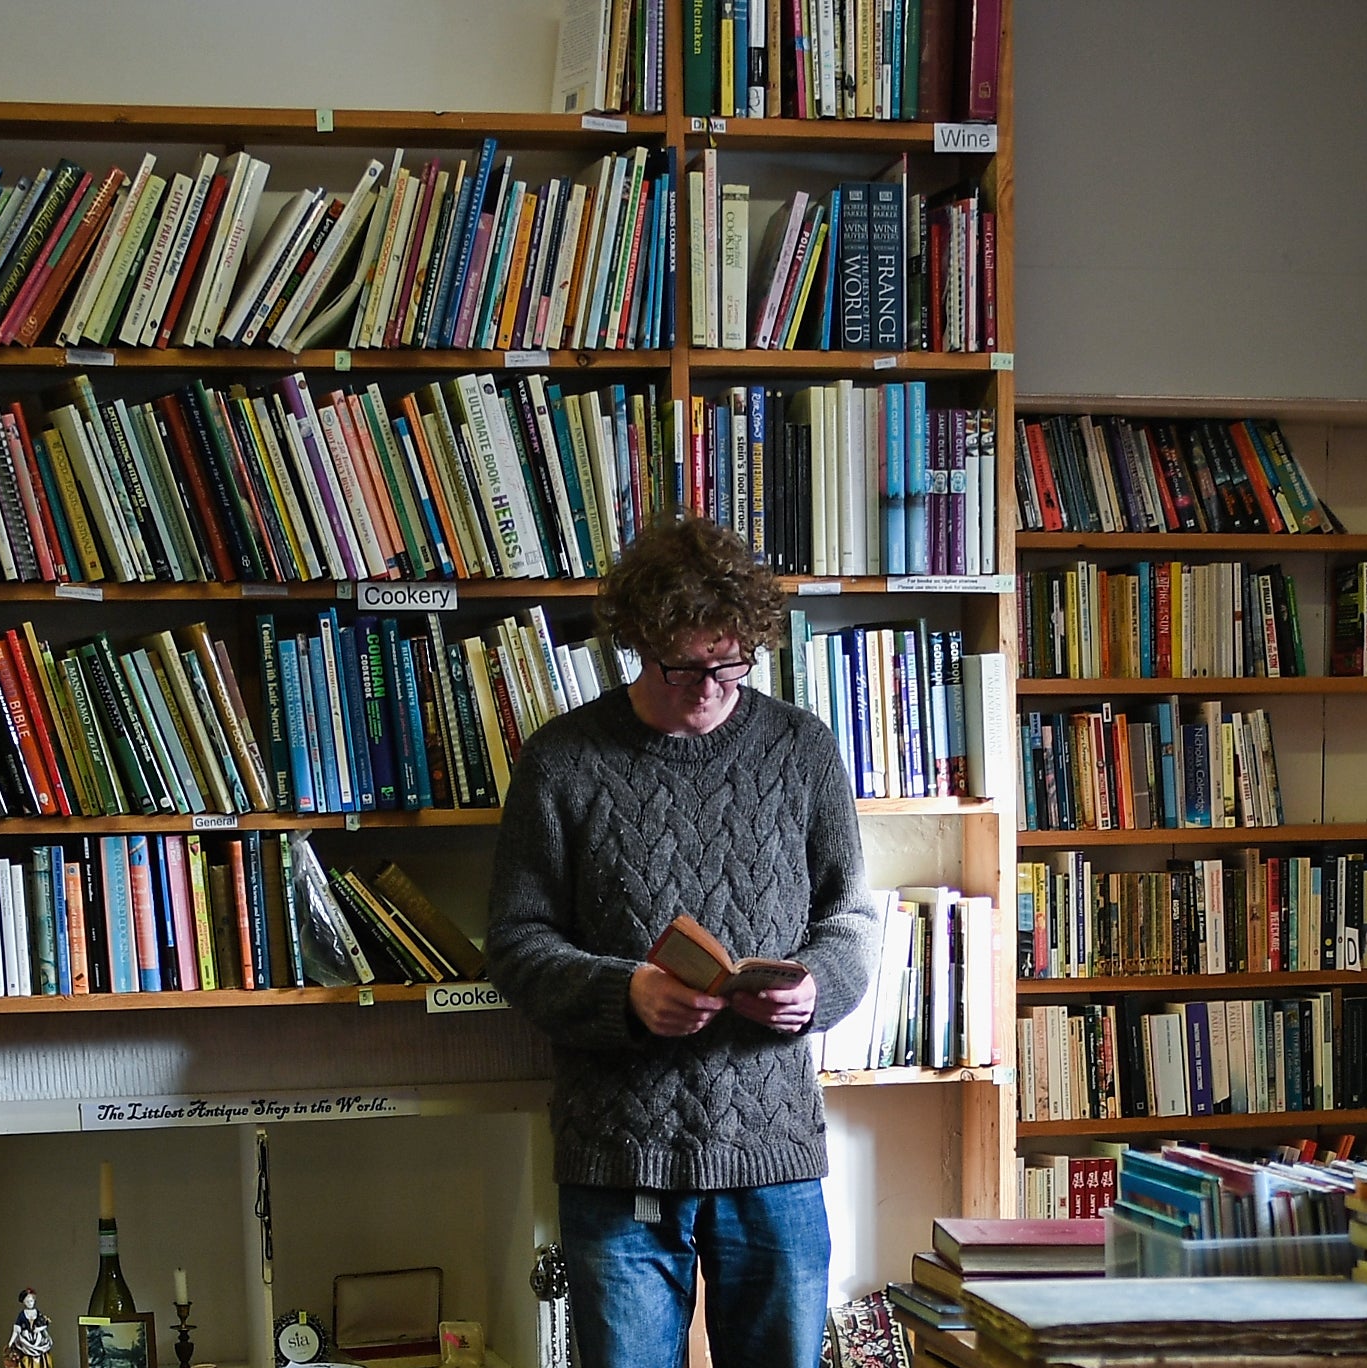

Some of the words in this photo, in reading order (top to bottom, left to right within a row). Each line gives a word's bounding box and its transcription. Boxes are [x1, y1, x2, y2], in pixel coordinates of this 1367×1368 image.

[693, 0, 702, 53] Heineken
[874, 21, 882, 43] wine
[874, 46, 882, 81] wisdom
[480, 143, 491, 163] THE
[940, 130, 990, 147] Wine
[36, 187, 65, 231] Complete
[163, 189, 183, 222] LITTLE
[387, 177, 406, 231] CARIBBEAN
[465, 166, 486, 229] VEGETARIAN
[19, 226, 45, 265] Chinese
[155, 222, 173, 248] PARIS
[221, 218, 248, 270] chinese
[724, 210, 734, 267] COOKERY
[793, 230, 810, 263] POLLY
[115, 239, 137, 279] KITCHEN
[140, 248, 164, 291] KITCHEN
[376, 234, 393, 277] COOKING
[452, 232, 471, 288] COOKBOOK
[844, 254, 863, 343] WORLD
[878, 255, 896, 343] FRANCE
[503, 396, 516, 417] WOK
[515, 378, 530, 404] WOK
[890, 387, 898, 409] JAMIE
[521, 403, 533, 415] &
[890, 410, 898, 436] OLIVER
[954, 411, 962, 435] JAMIE
[324, 426, 335, 444] HOT
[330, 445, 338, 453] &
[508, 417, 529, 466] COOKBOOK
[718, 437, 726, 455] THE
[105, 404, 132, 463] ENTERTAINING
[124, 461, 140, 484] WITH
[132, 482, 148, 509] TOVEY
[332, 452, 345, 474] SPICY
[737, 435, 748, 469] stein's
[954, 437, 962, 467] OLIVER
[445, 434, 461, 467] FONDUE
[455, 468, 472, 506] COOKING
[737, 471, 748, 496] food
[752, 441, 764, 512] MEDITERRANEAN
[339, 475, 354, 505] DISHES
[719, 490, 731, 522] AWT
[491, 492, 527, 558] HERBS
[737, 496, 748, 532] heroes
[752, 515, 764, 553] ESCAPES
[364, 586, 450, 607] Cookery
[1157, 570, 1170, 605] EMPIRE
[532, 615, 546, 640] new
[1159, 614, 1171, 634] SUN
[1264, 617, 1276, 644] EMPIRE
[259, 623, 275, 660] Cooking
[400, 645, 411, 668] RICK
[264, 659, 276, 680] with
[280, 651, 291, 679] FOOD
[358, 652, 373, 699] COOKBOOK
[365, 632, 388, 698] CONRAN
[931, 642, 946, 685] GORDON
[948, 641, 963, 685] GORDON
[1268, 652, 1279, 669] SUN
[267, 680, 280, 708] Katie
[284, 681, 294, 700] AND
[404, 671, 417, 705] STEIN'S
[7, 699, 31, 739] BIBLE
[269, 708, 282, 742] Stewart
[287, 702, 300, 746] COOKING
[1193, 726, 1204, 767] Nicholas
[274, 770, 289, 806] Hamlyn
[1192, 768, 1206, 815] Coleridge
[195, 816, 236, 828] General
[248, 836, 256, 851] Food
[249, 883, 259, 906] Science
[252, 906, 260, 916] and
[252, 916, 262, 946] Marketing
[1268, 910, 1280, 952] WRECKAGE
[1347, 938, 1357, 965] D
[1209, 1009, 1219, 1047] FAULKS
[1228, 1004, 1236, 1042] FAULKS
[97, 1104, 124, 1120] The
[127, 1103, 184, 1120] Littlest
[187, 1100, 249, 1122] Antique
[253, 1099, 291, 1120] Shop
[293, 1103, 307, 1115] in
[309, 1102, 331, 1114] the
[287, 1332, 310, 1349] sia
